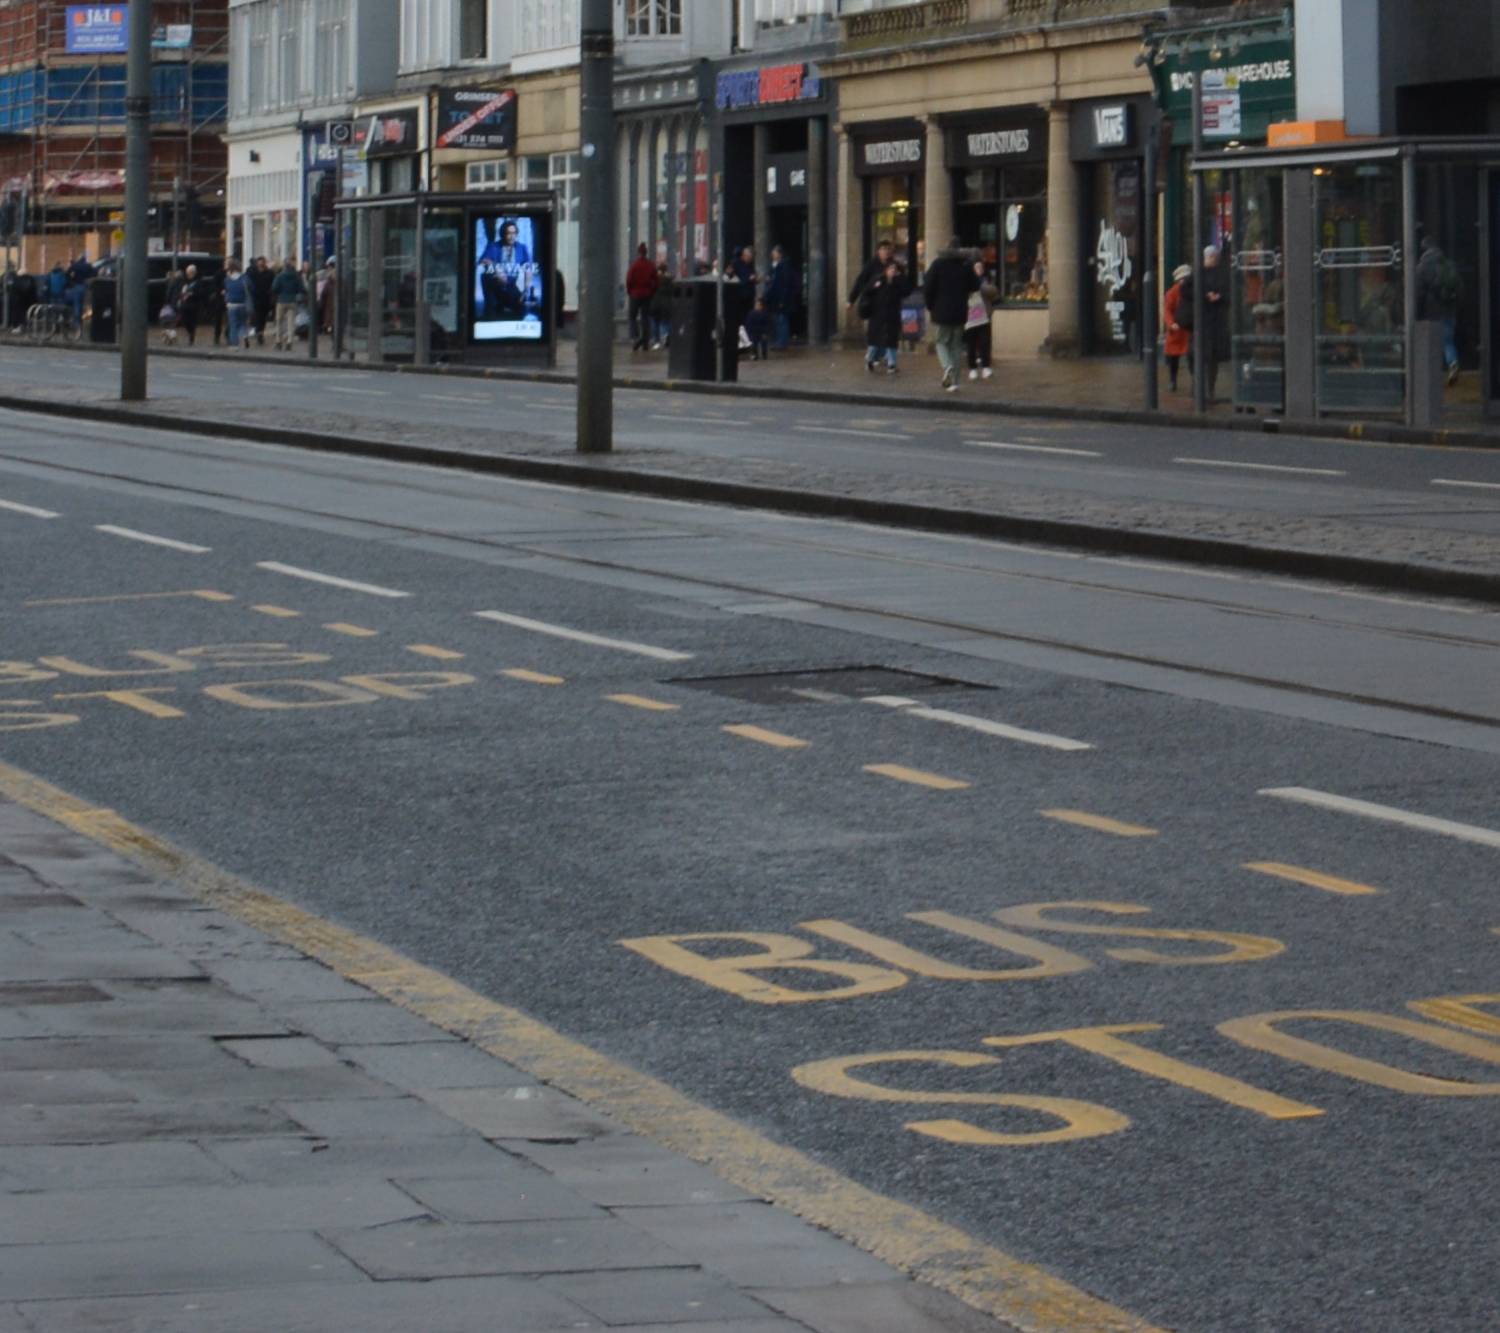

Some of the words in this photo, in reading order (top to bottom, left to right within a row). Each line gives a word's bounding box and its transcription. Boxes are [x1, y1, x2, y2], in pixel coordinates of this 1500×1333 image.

[1095, 107, 1124, 143] VANS
[865, 139, 921, 165] WATERSTONES
[967, 129, 1029, 156] WATERSTONES
[620, 900, 1288, 1004] BUS
